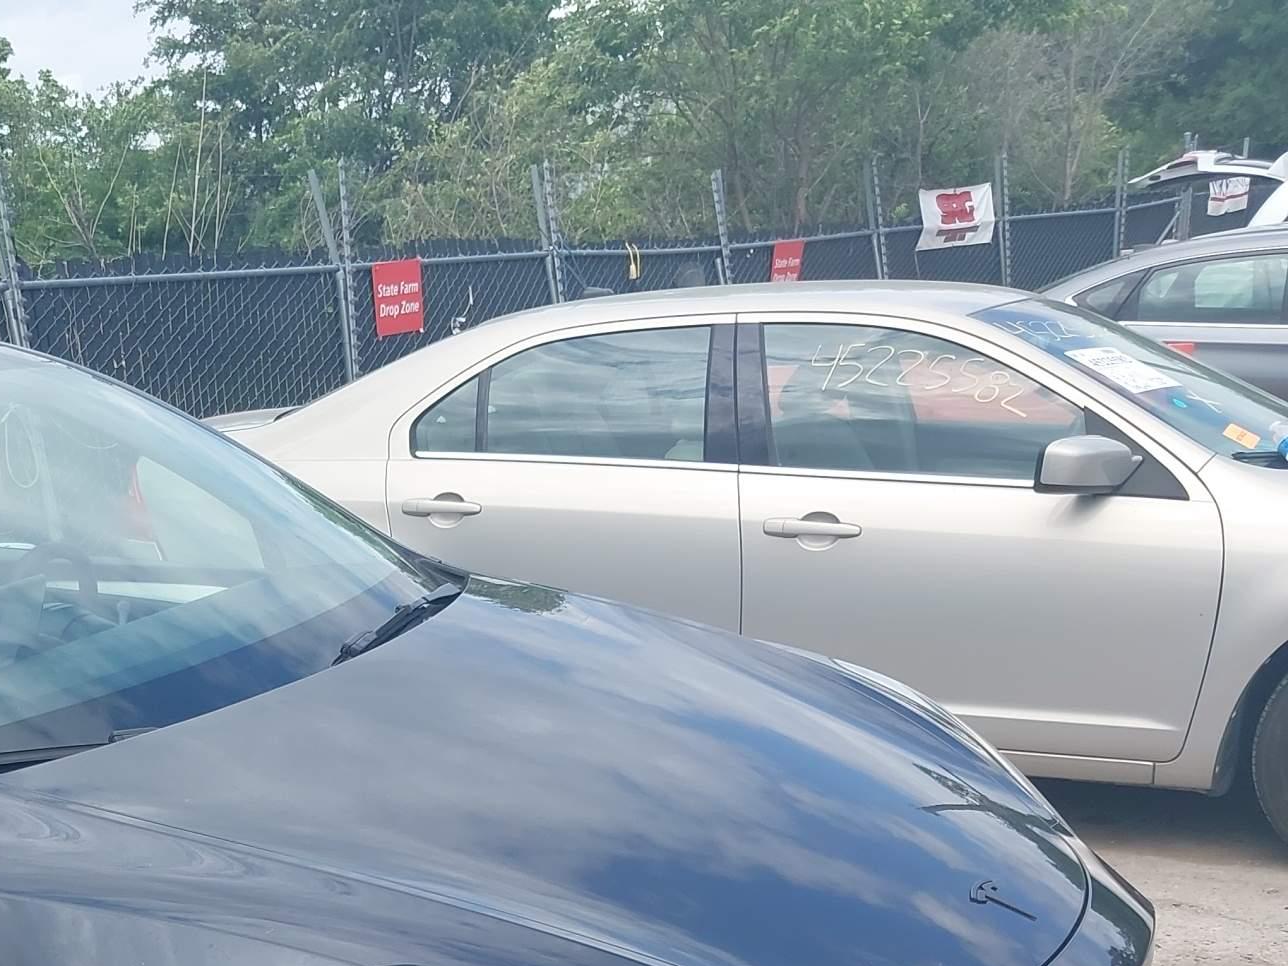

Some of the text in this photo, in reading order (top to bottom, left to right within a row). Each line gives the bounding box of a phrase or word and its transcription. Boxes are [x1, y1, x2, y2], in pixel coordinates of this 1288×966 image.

[377, 280, 419, 298] State Farm
[379, 300, 420, 319] Drop Zone
[811, 343, 1027, 417] 45225582
